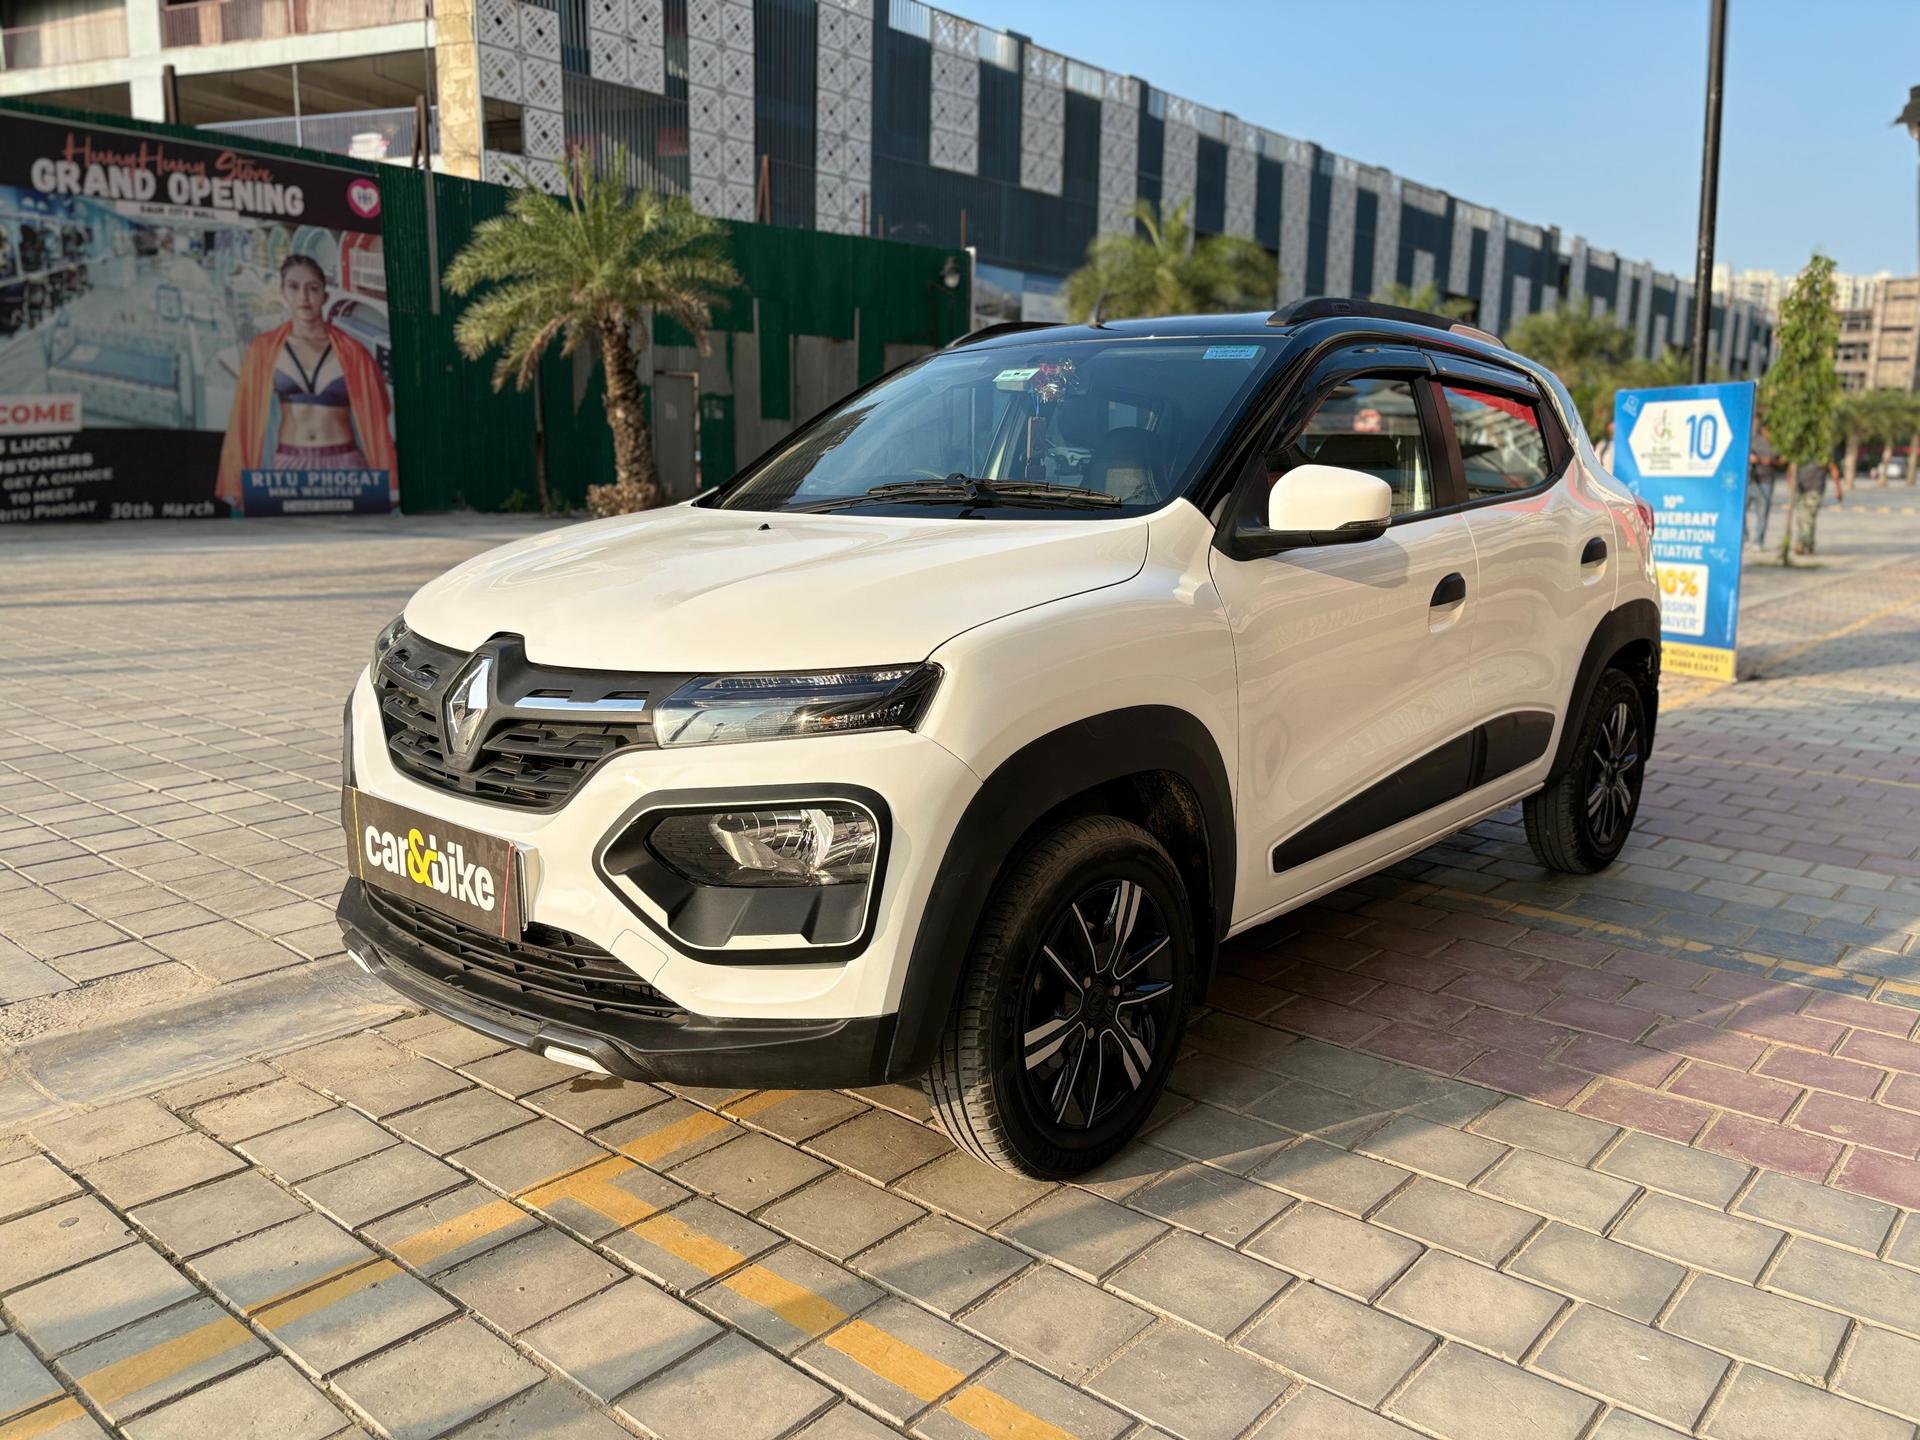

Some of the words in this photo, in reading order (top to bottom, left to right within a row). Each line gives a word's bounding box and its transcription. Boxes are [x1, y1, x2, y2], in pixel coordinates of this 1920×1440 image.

[215, 150, 274, 182] Store
[31, 157, 157, 201] GRAND
[167, 171, 304, 216] OPENING
[10, 435, 73, 454] LUCKY
[1685, 414, 1718, 460] 10
[2, 476, 34, 490] GET
[36, 475, 48, 487] A
[50, 467, 114, 486] CHANCE
[251, 471, 298, 487] RITU
[307, 471, 381, 487] PHOGAT
[9, 491, 31, 505] TO
[33, 488, 75, 503] MEET
[33, 500, 98, 519] PHOGAT
[110, 501, 155, 519] 30th
[161, 500, 215, 518] March
[365, 825, 495, 912] car&bike
